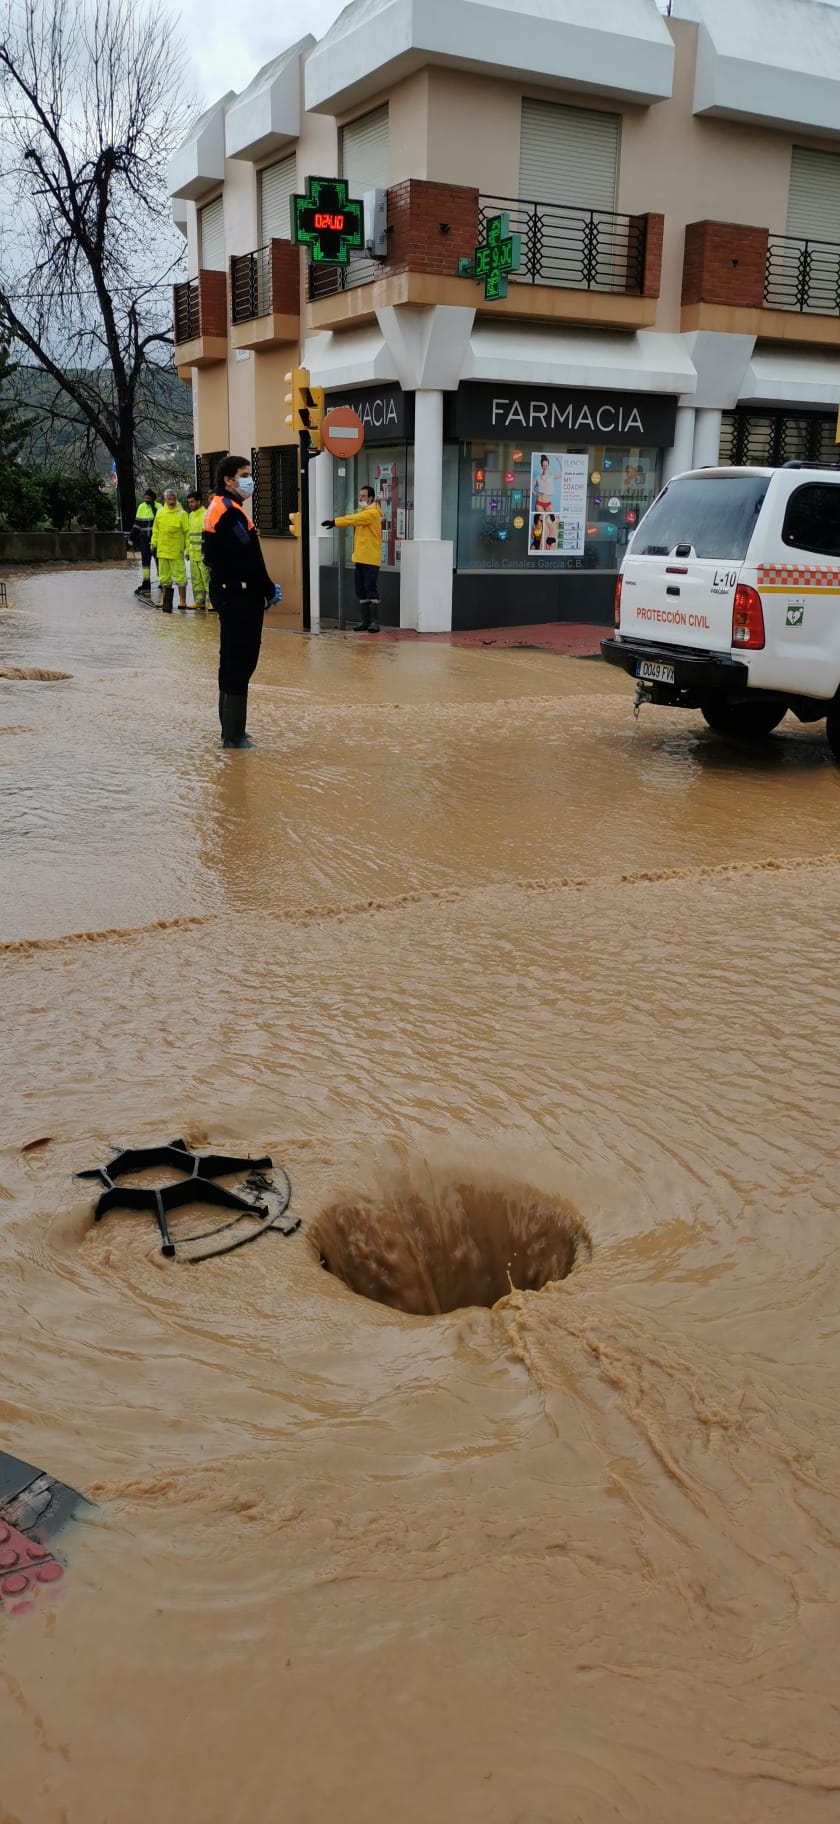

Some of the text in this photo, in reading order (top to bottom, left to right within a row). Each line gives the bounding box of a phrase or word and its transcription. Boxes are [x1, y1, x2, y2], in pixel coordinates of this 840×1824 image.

[491, 398, 645, 434] FARMACIA
[713, 570, 736, 588] L-10
[636, 607, 710, 629] PROTECCIÓN CIVIL
